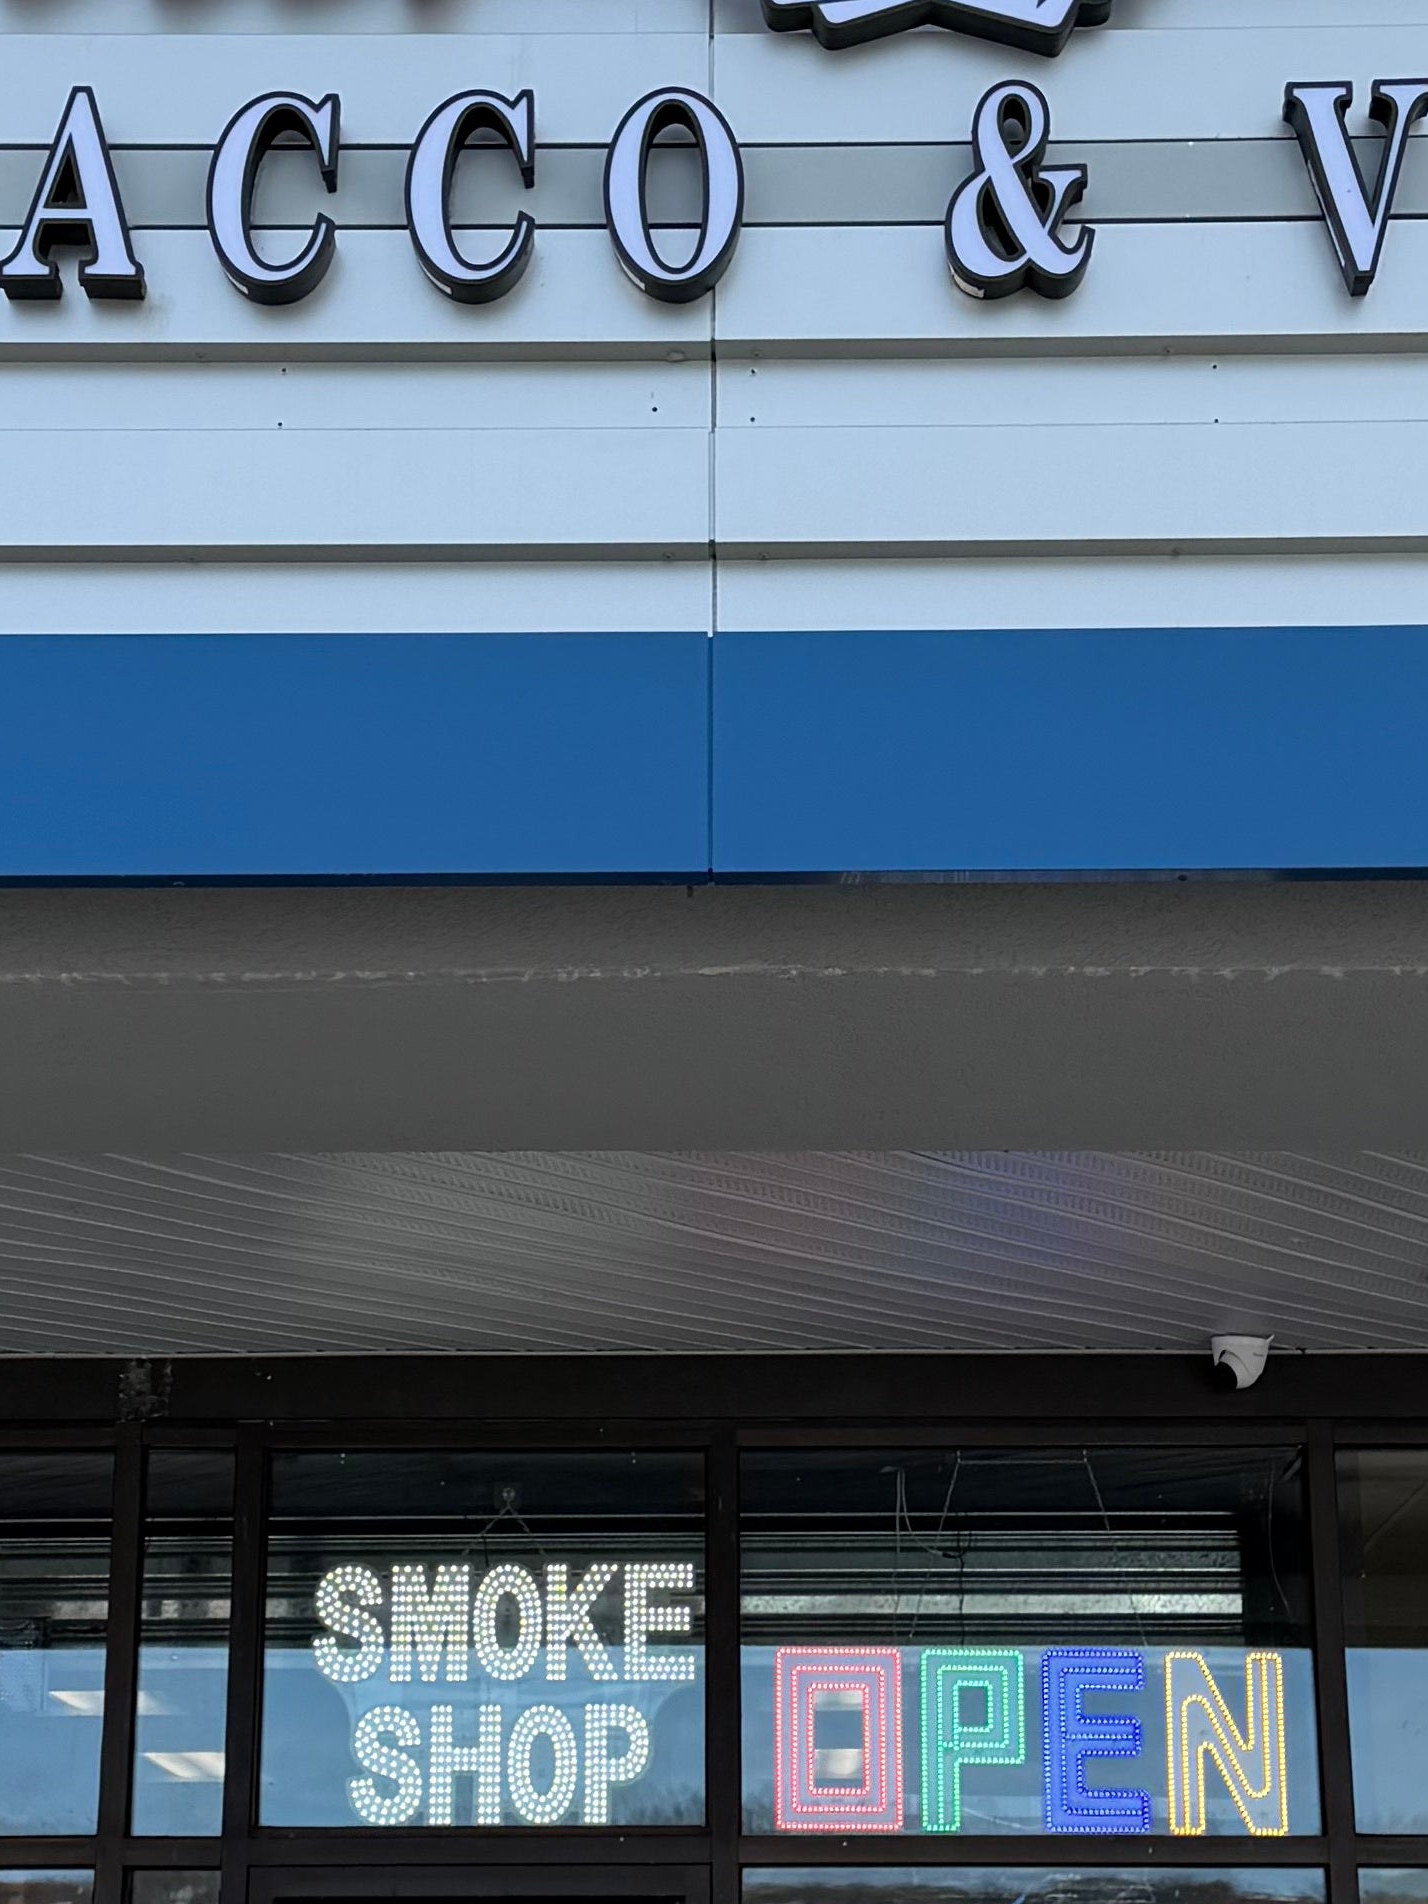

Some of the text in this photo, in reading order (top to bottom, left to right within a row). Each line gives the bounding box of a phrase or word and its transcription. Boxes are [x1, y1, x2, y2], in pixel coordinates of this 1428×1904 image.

[943, 78, 1096, 299] &
[312, 1561, 697, 1684] SMOKE
[349, 1702, 652, 1827] SHOP
[775, 1645, 1289, 1837] OPEN
